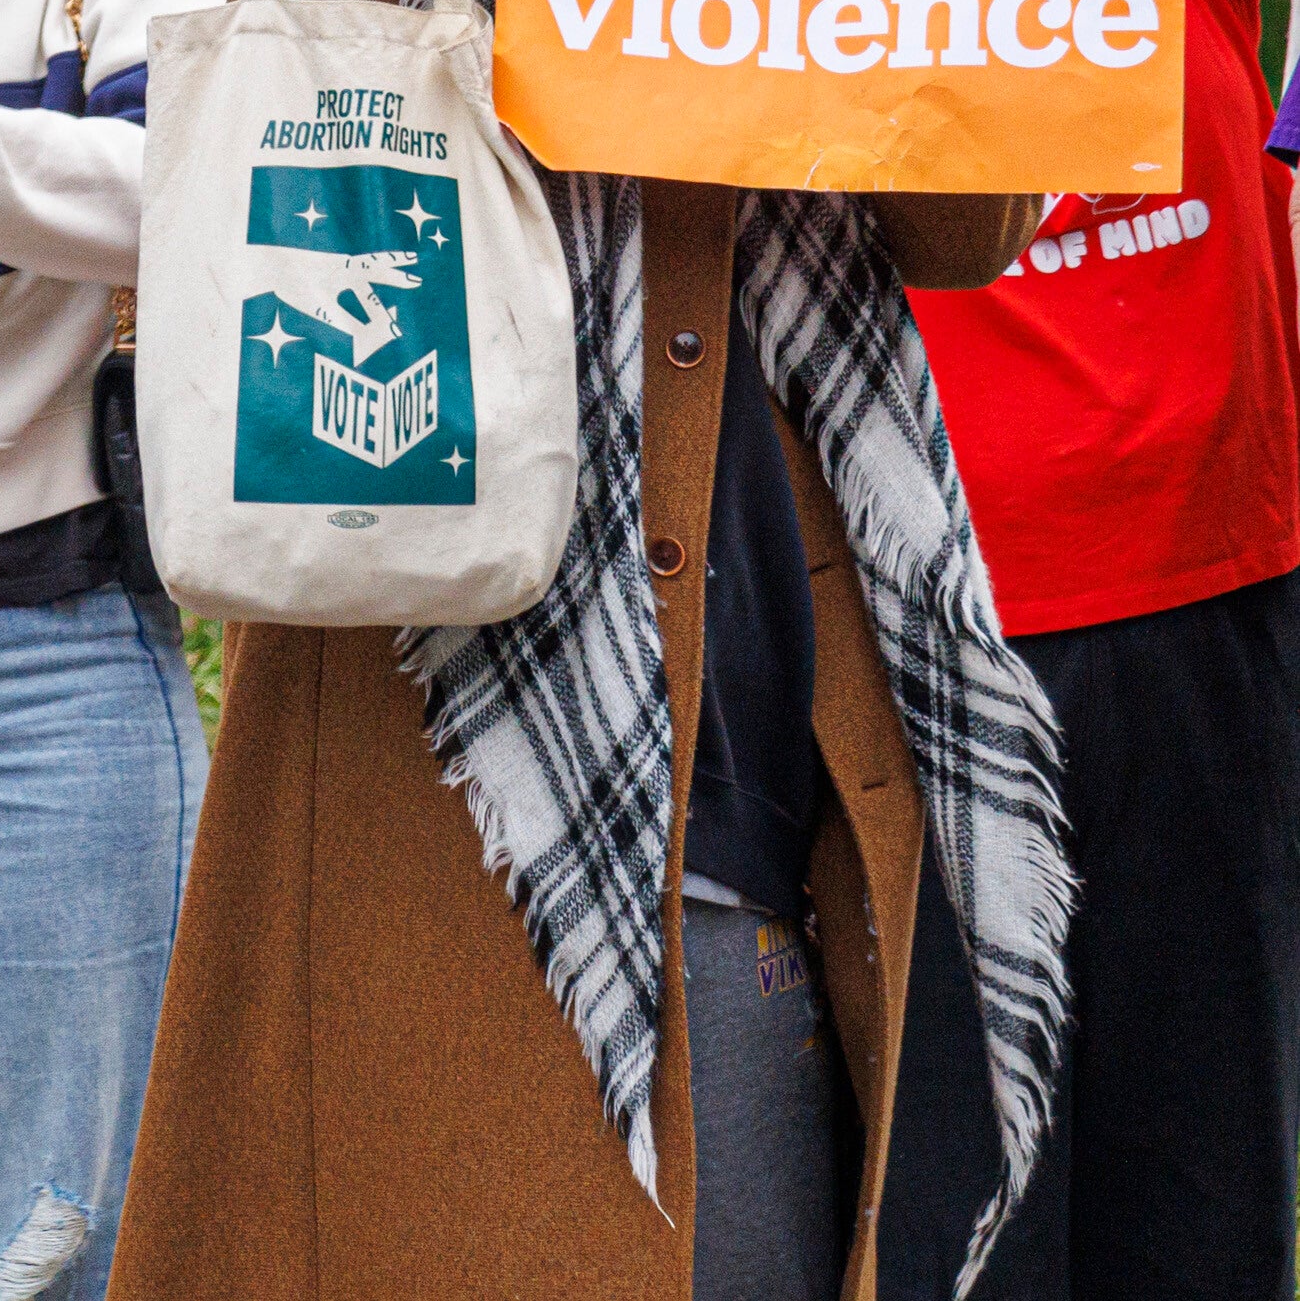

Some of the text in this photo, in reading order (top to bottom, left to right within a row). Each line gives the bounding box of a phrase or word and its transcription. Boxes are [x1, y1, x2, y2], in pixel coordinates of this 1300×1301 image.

[260, 120, 448, 161] ABORTION RIGHTS
[316, 88, 405, 122] PROTECT
[1029, 198, 1211, 275] OF MIND
[320, 364, 379, 455] VOTE
[391, 360, 434, 452] VOTE
